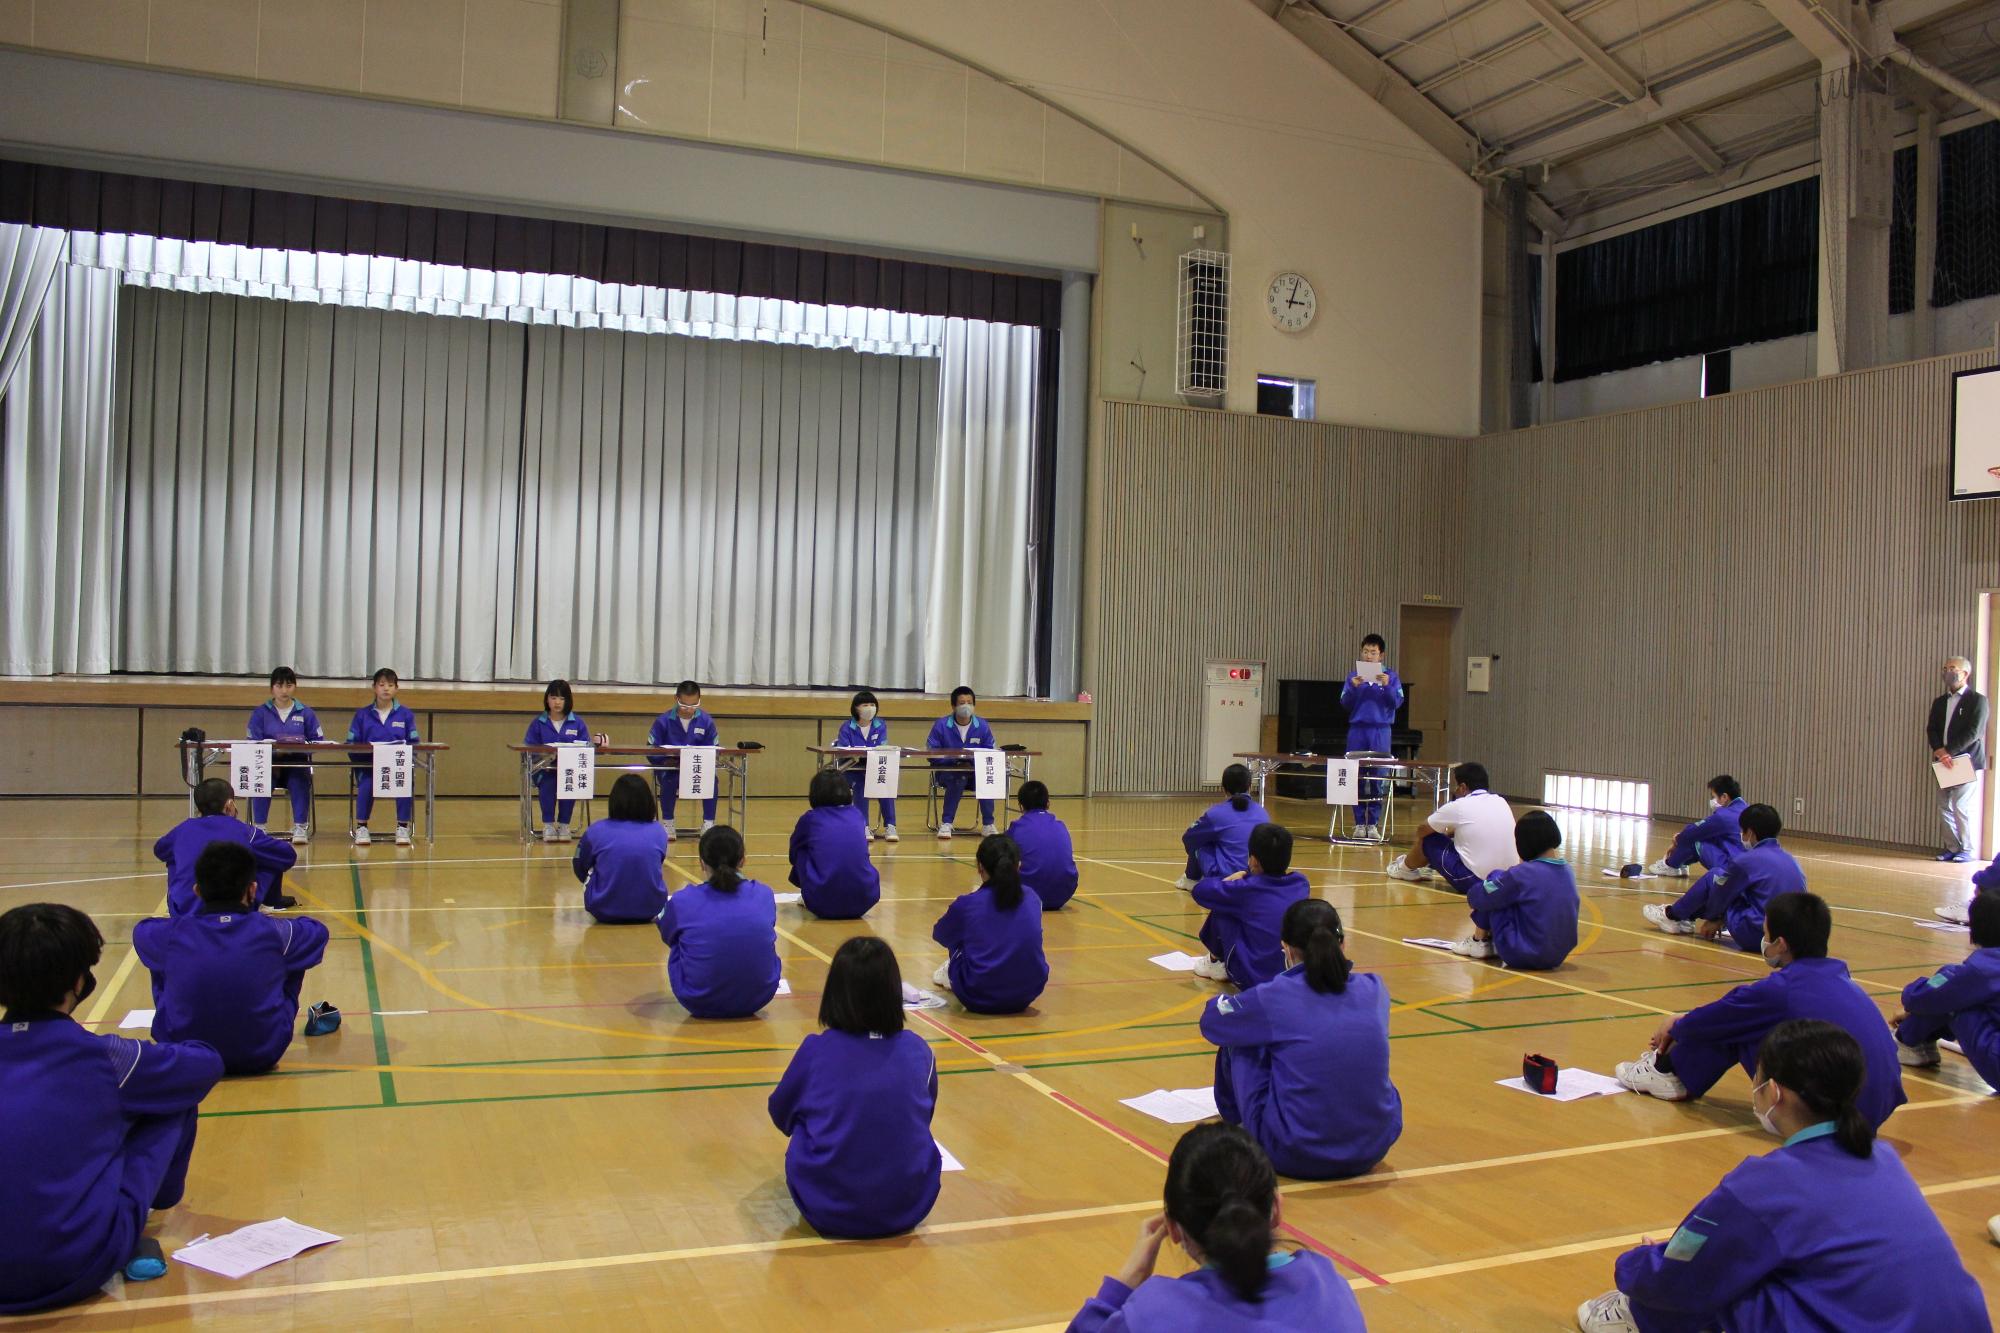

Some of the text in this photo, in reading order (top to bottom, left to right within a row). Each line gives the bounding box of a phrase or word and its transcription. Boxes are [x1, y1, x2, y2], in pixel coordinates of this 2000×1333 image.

[239, 765, 249, 790] 委員長
[381, 766, 391, 790] 委員長
[395, 750, 405, 787] 学習・図書
[564, 768, 574, 792] 委員長
[578, 753, 588, 789] 生活・保体
[692, 754, 702, 794] 生徒会長
[877, 755, 887, 784] 副会長
[986, 756, 994, 785] 書記長
[1338, 768, 1347, 787] 議長
